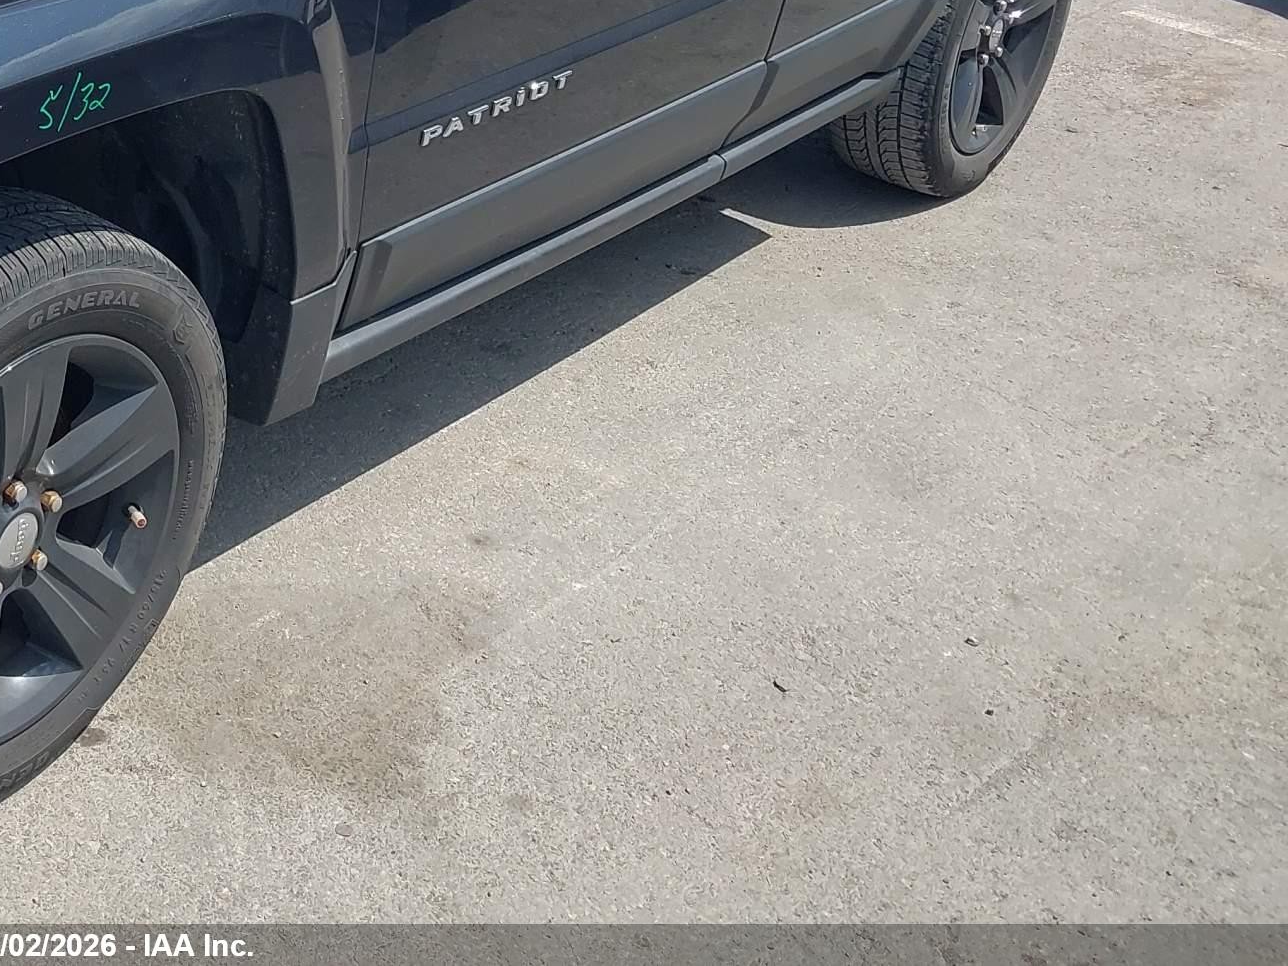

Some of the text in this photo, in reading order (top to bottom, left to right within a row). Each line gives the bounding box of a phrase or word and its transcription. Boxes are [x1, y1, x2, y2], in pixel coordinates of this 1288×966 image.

[39, 72, 111, 132] 5/32
[419, 70, 573, 147] PATRIOT
[28, 290, 141, 331] GENERAL
